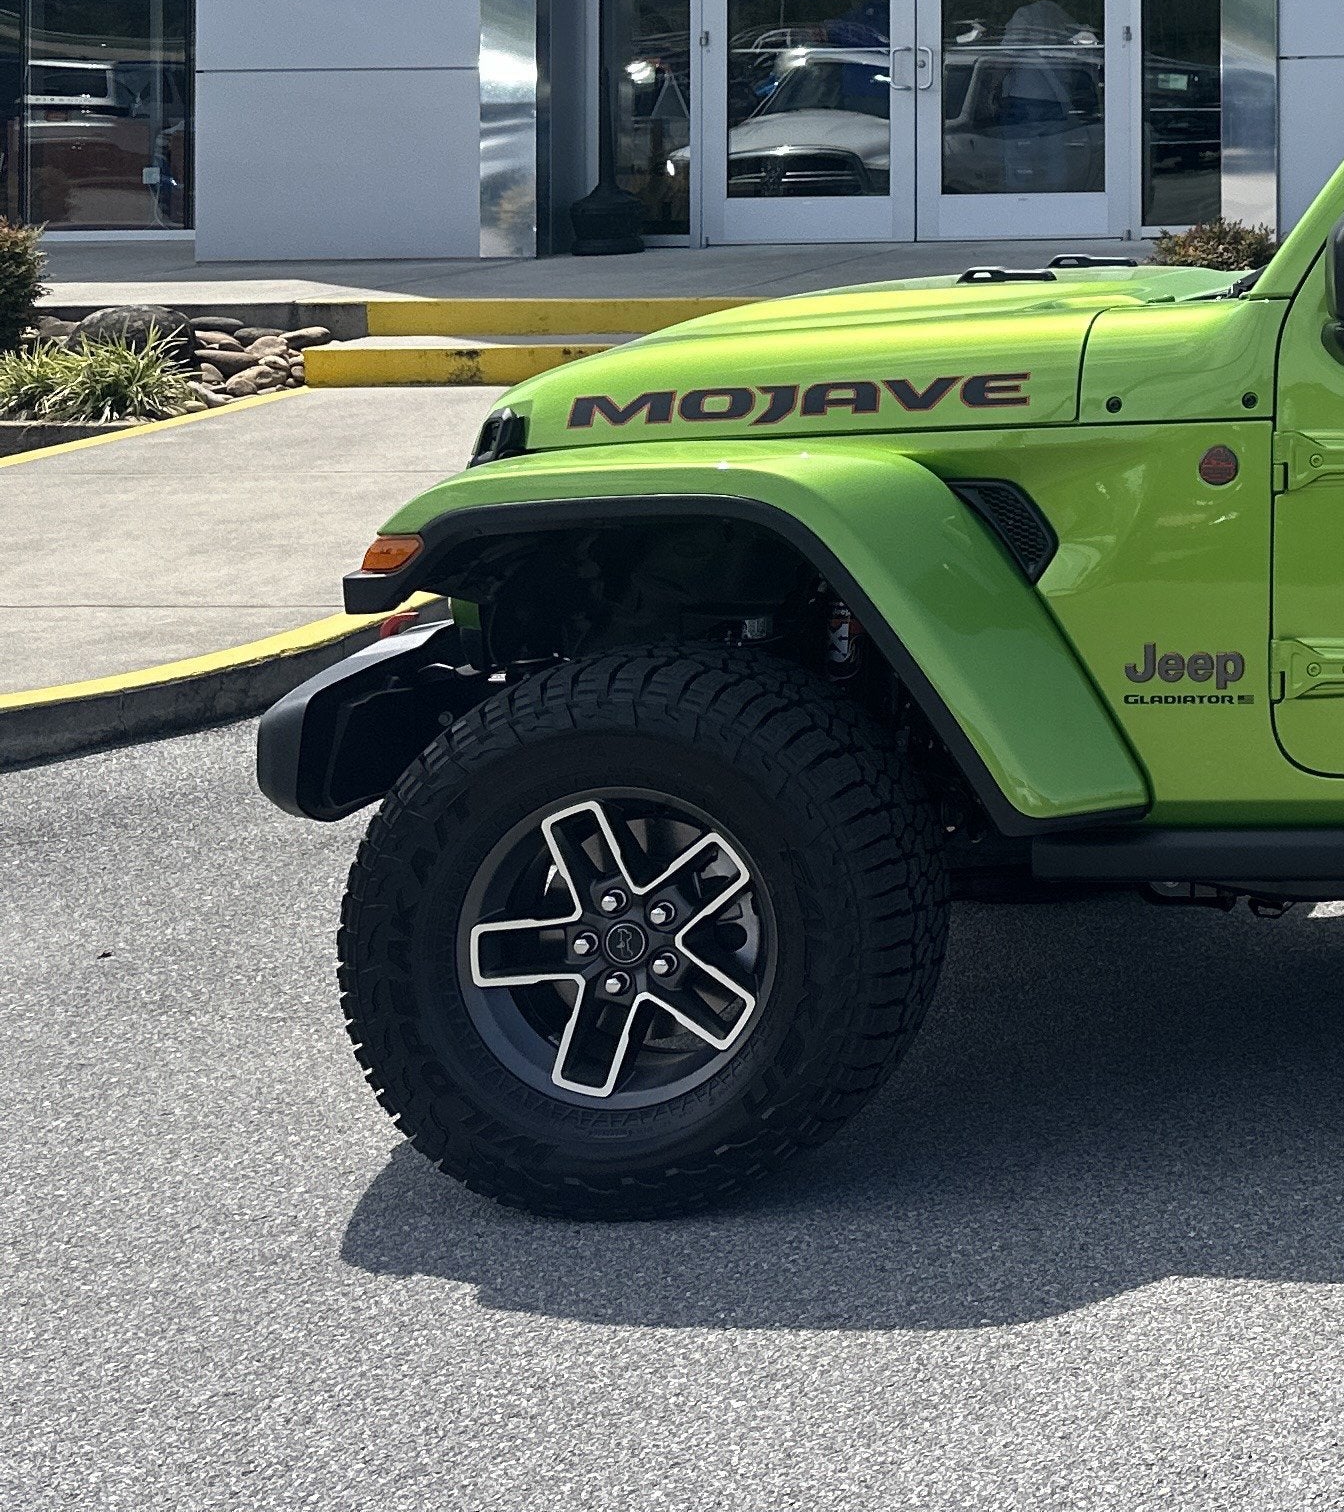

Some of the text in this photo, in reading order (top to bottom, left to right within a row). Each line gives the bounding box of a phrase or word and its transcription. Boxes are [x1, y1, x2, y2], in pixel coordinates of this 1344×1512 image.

[566, 372, 1031, 429] MOJAVE
[1124, 641, 1245, 691] Jeep
[1123, 694, 1234, 705] GLADIATOR
